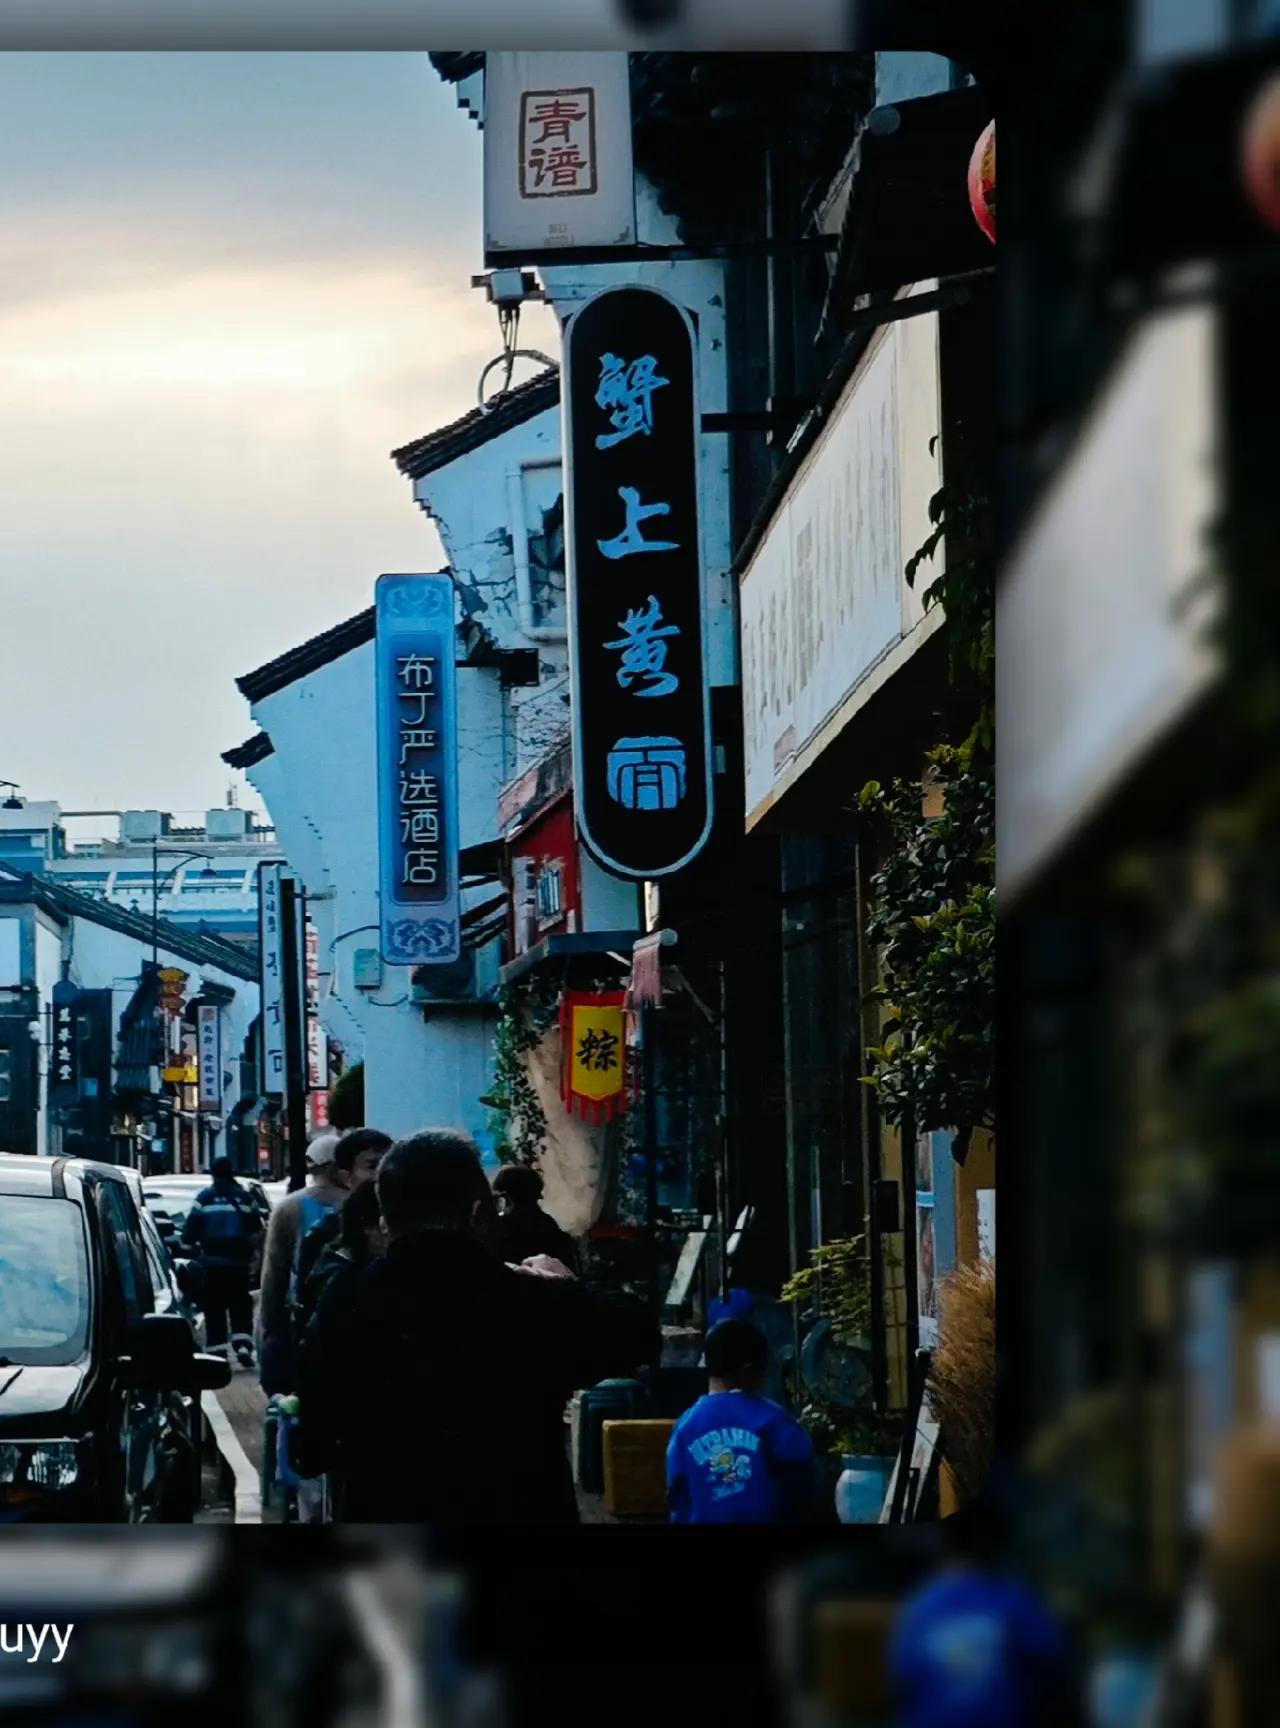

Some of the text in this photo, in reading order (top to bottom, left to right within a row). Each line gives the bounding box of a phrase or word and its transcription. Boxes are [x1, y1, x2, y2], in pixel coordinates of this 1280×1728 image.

[528, 99, 589, 188] 青谱
[397, 652, 439, 885] 布丁严选酒店
[575, 1027, 621, 1072] 粽
